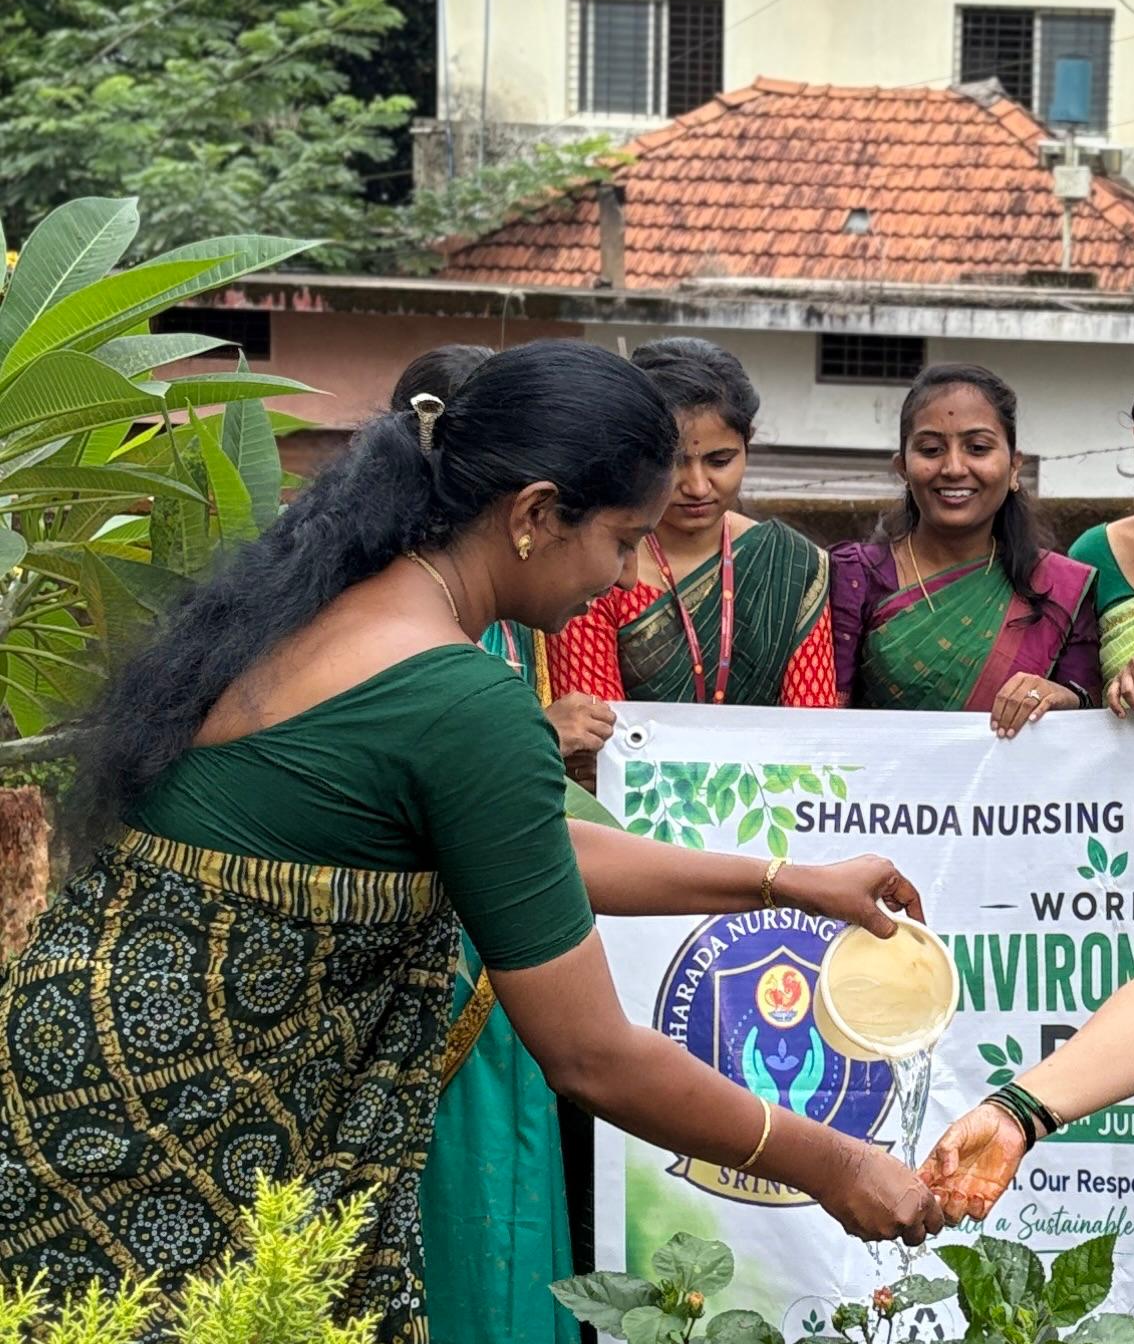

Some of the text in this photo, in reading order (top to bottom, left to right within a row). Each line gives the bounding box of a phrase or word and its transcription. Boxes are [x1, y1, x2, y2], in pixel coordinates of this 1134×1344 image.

[794, 800, 963, 836] SHARADA
[972, 801, 1124, 836] NURSING
[669, 907, 837, 1050] HARADA NURSING
[717, 1166, 801, 1195] SRIN
[1029, 1168, 1070, 1192] Our
[995, 1216, 1011, 1232] a
